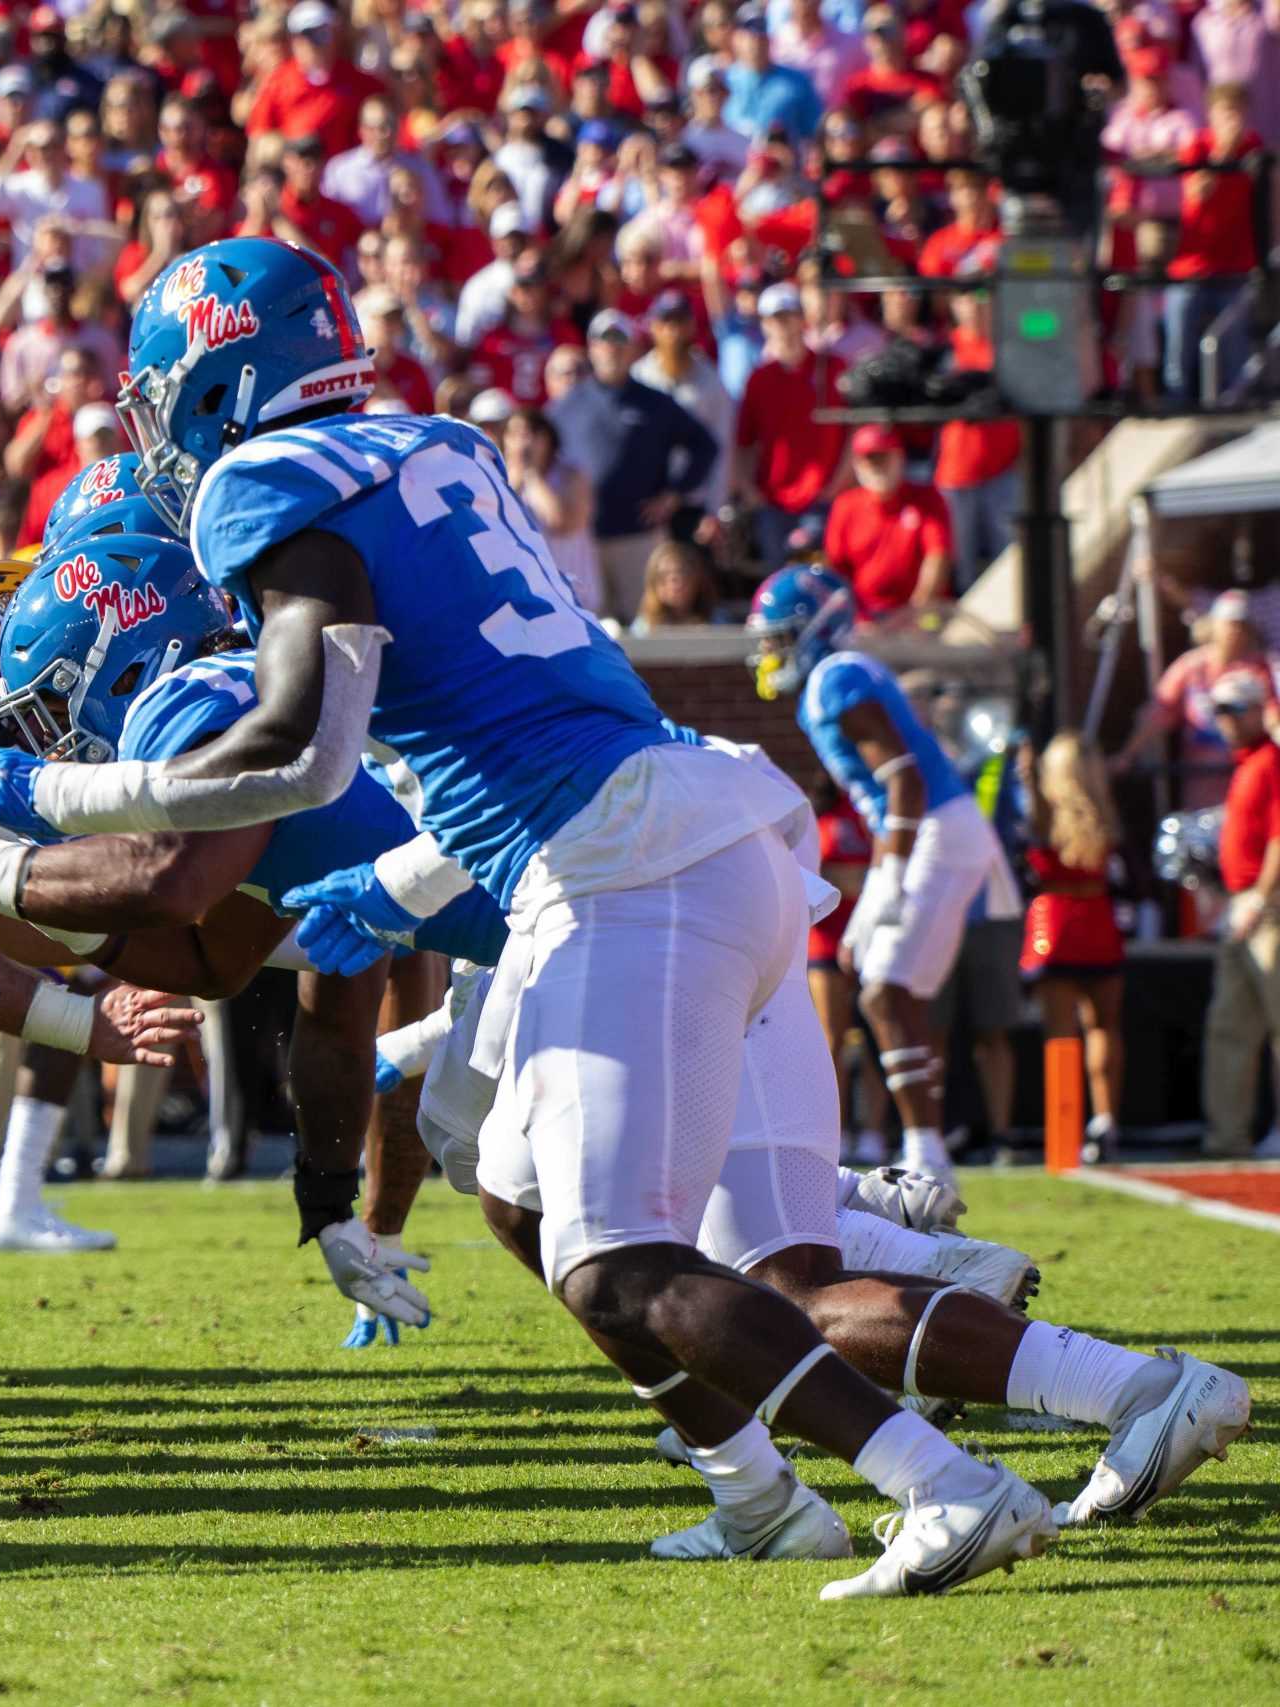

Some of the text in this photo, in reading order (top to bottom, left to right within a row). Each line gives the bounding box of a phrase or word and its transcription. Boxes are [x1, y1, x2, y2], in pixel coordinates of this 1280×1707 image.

[161, 254, 261, 353] Ole Miss
[300, 371, 358, 399] HOTTY
[80, 458, 121, 494] Ole
[54, 554, 102, 602] Ole
[85, 582, 167, 636] Miss
